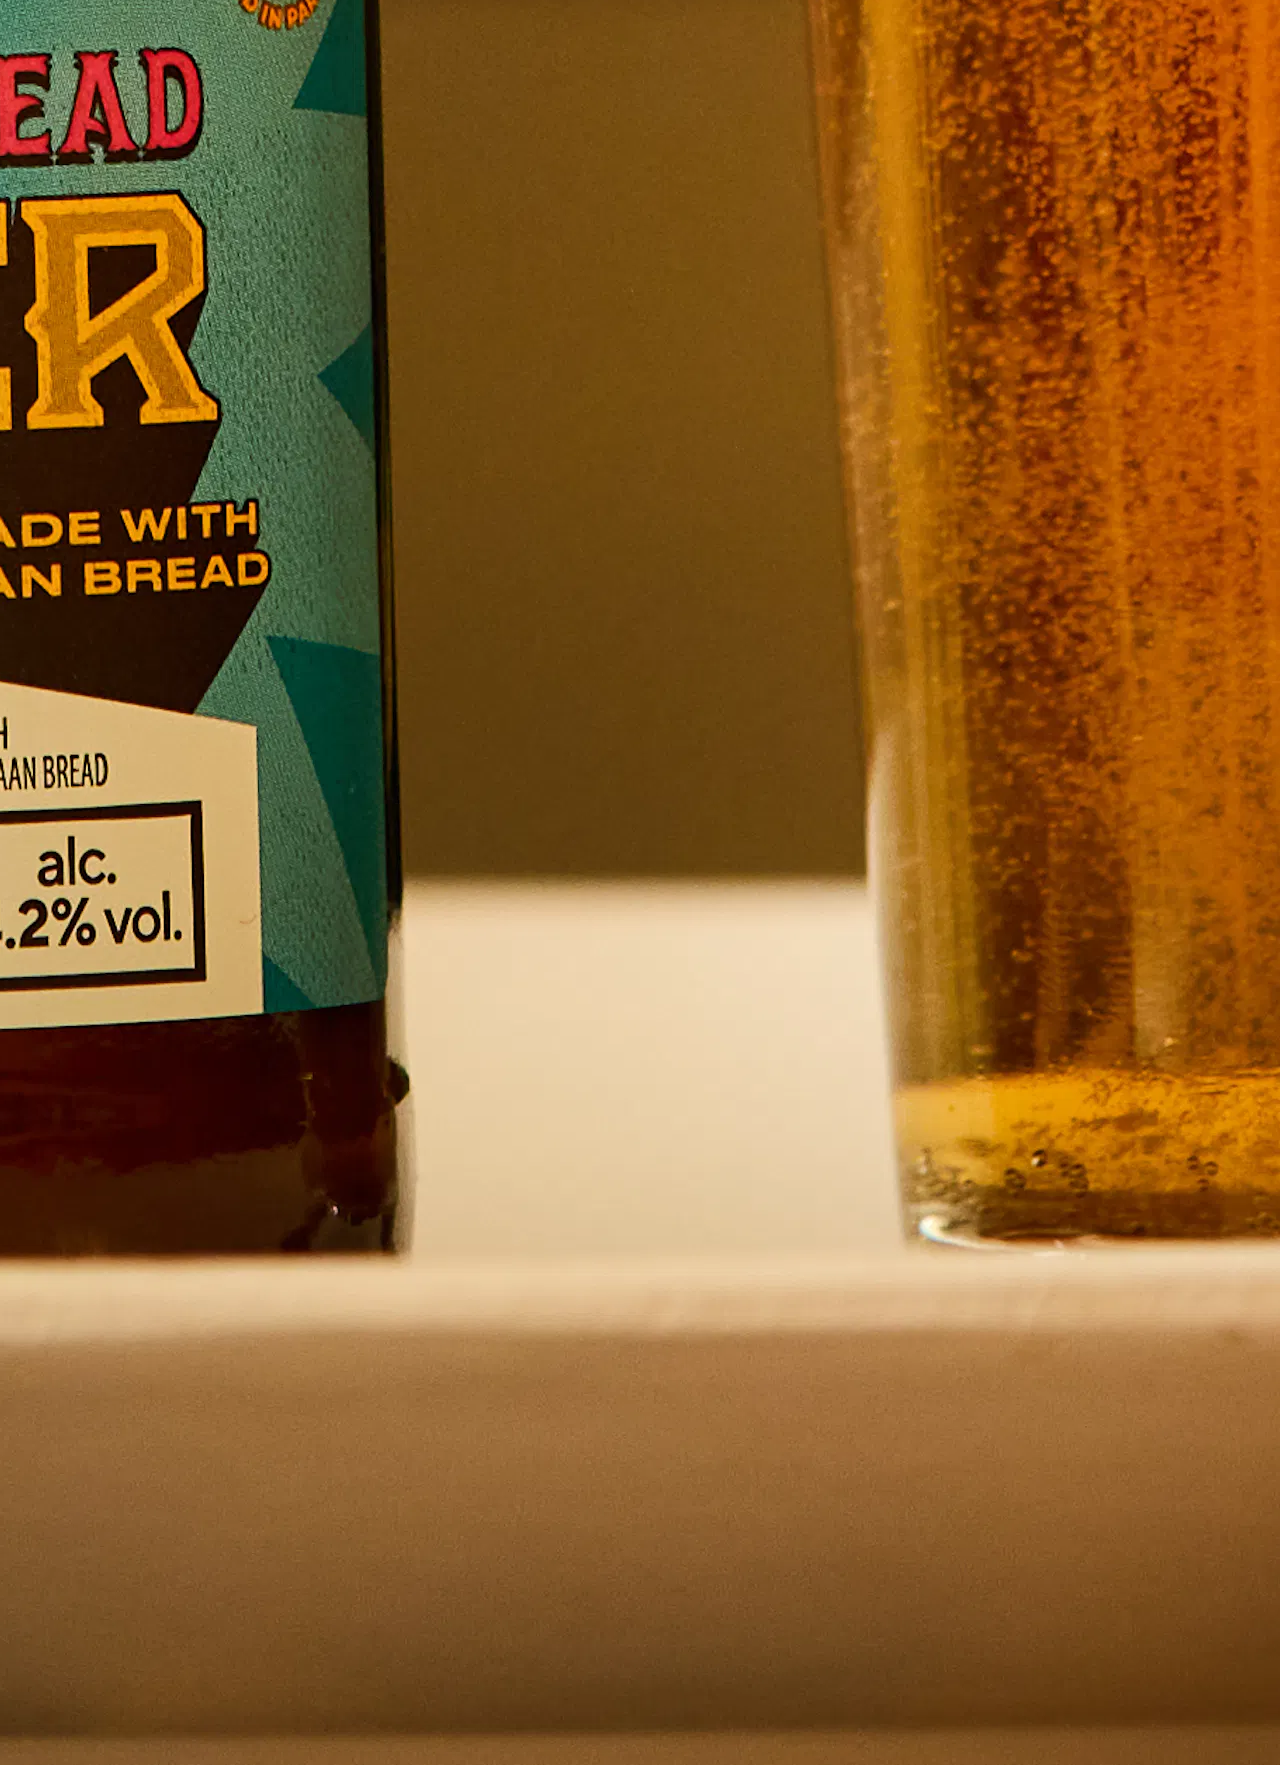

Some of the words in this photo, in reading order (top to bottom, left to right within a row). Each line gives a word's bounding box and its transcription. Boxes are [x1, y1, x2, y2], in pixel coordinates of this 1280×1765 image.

[259, 4, 283, 30] IN
[120, 501, 259, 543] WITH
[83, 551, 271, 597] BREAD
[42, 752, 109, 789] BREAD
[36, 835, 117, 888] alc.
[103, 889, 184, 943] vol.
